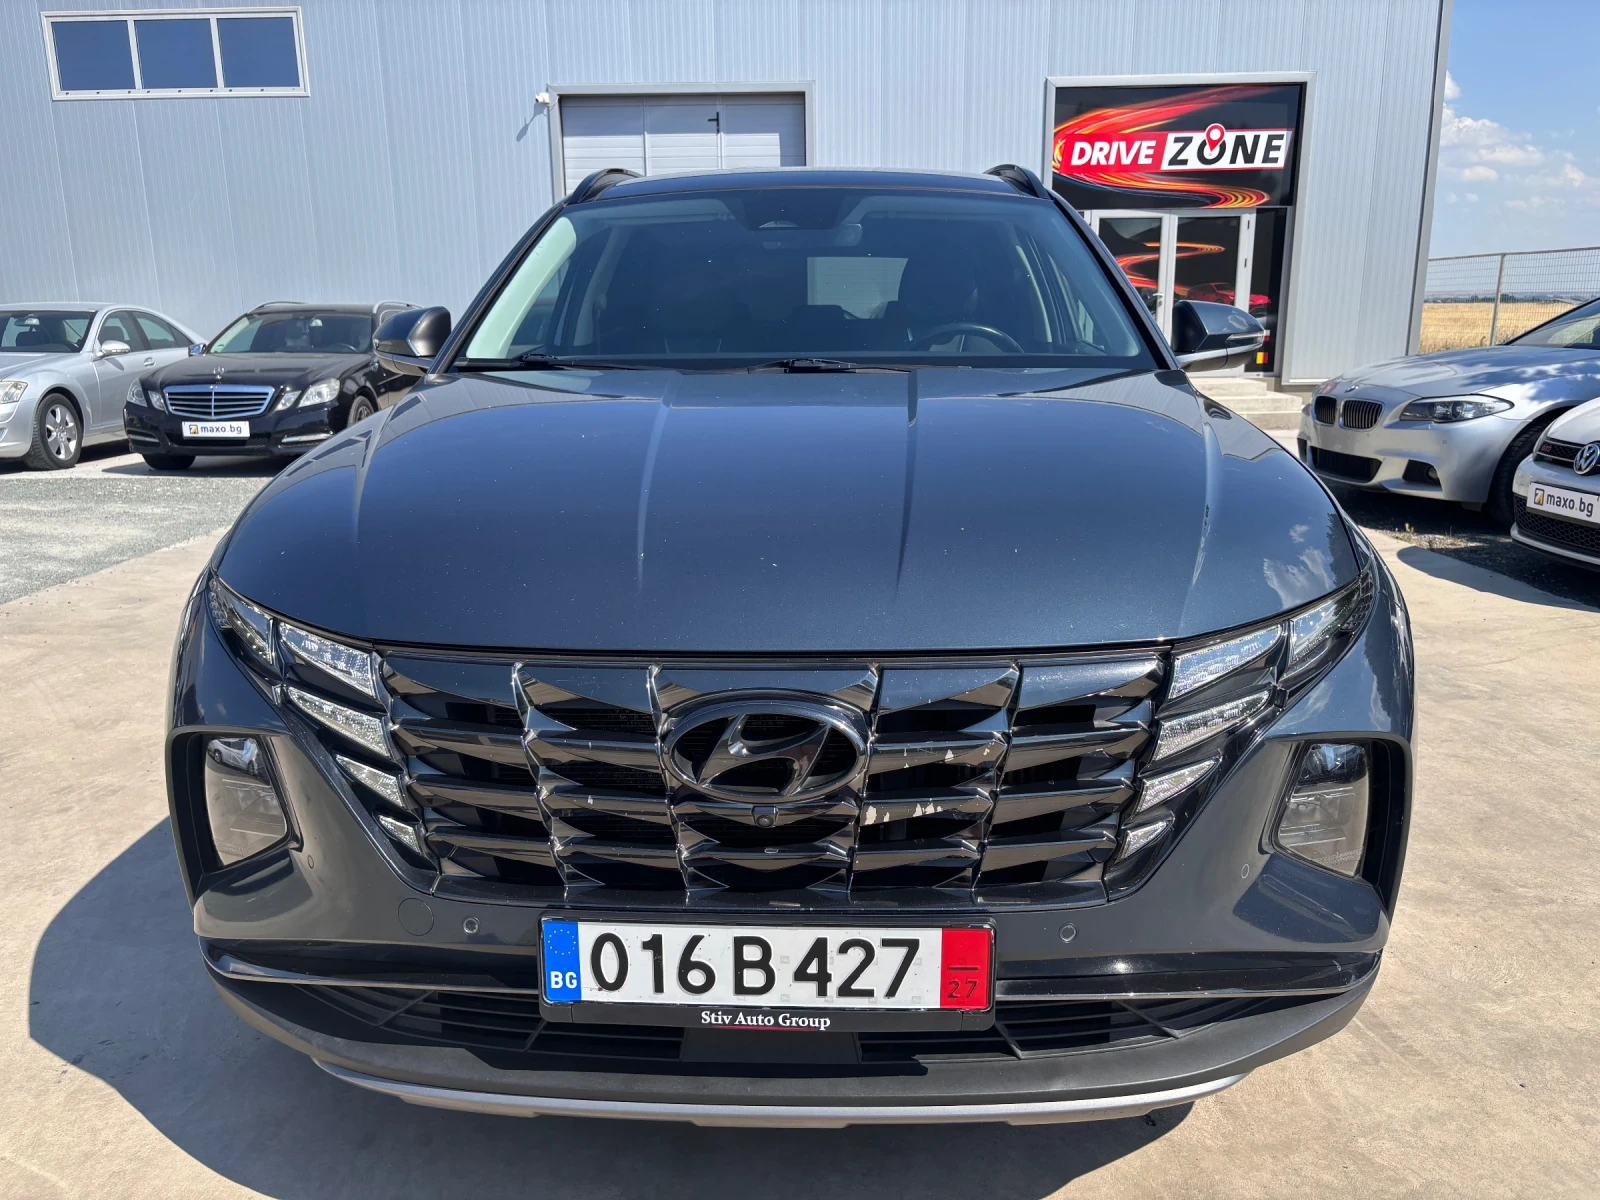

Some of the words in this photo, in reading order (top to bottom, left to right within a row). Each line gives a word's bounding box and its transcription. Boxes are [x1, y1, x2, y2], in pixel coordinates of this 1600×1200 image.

[1070, 140, 1156, 166] DRIVE
[1168, 133, 1285, 167] ZONE
[200, 424, 242, 434] maxo.bg
[1546, 493, 1594, 518] maxo.bg
[590, 932, 716, 995] 016
[733, 936, 776, 995] B
[793, 936, 921, 999] 427
[550, 971, 578, 989] BG
[947, 980, 978, 998] 27
[701, 1010, 732, 1024] Stiv
[733, 1011, 775, 1026] Auto
[778, 1013, 831, 1031] Group
